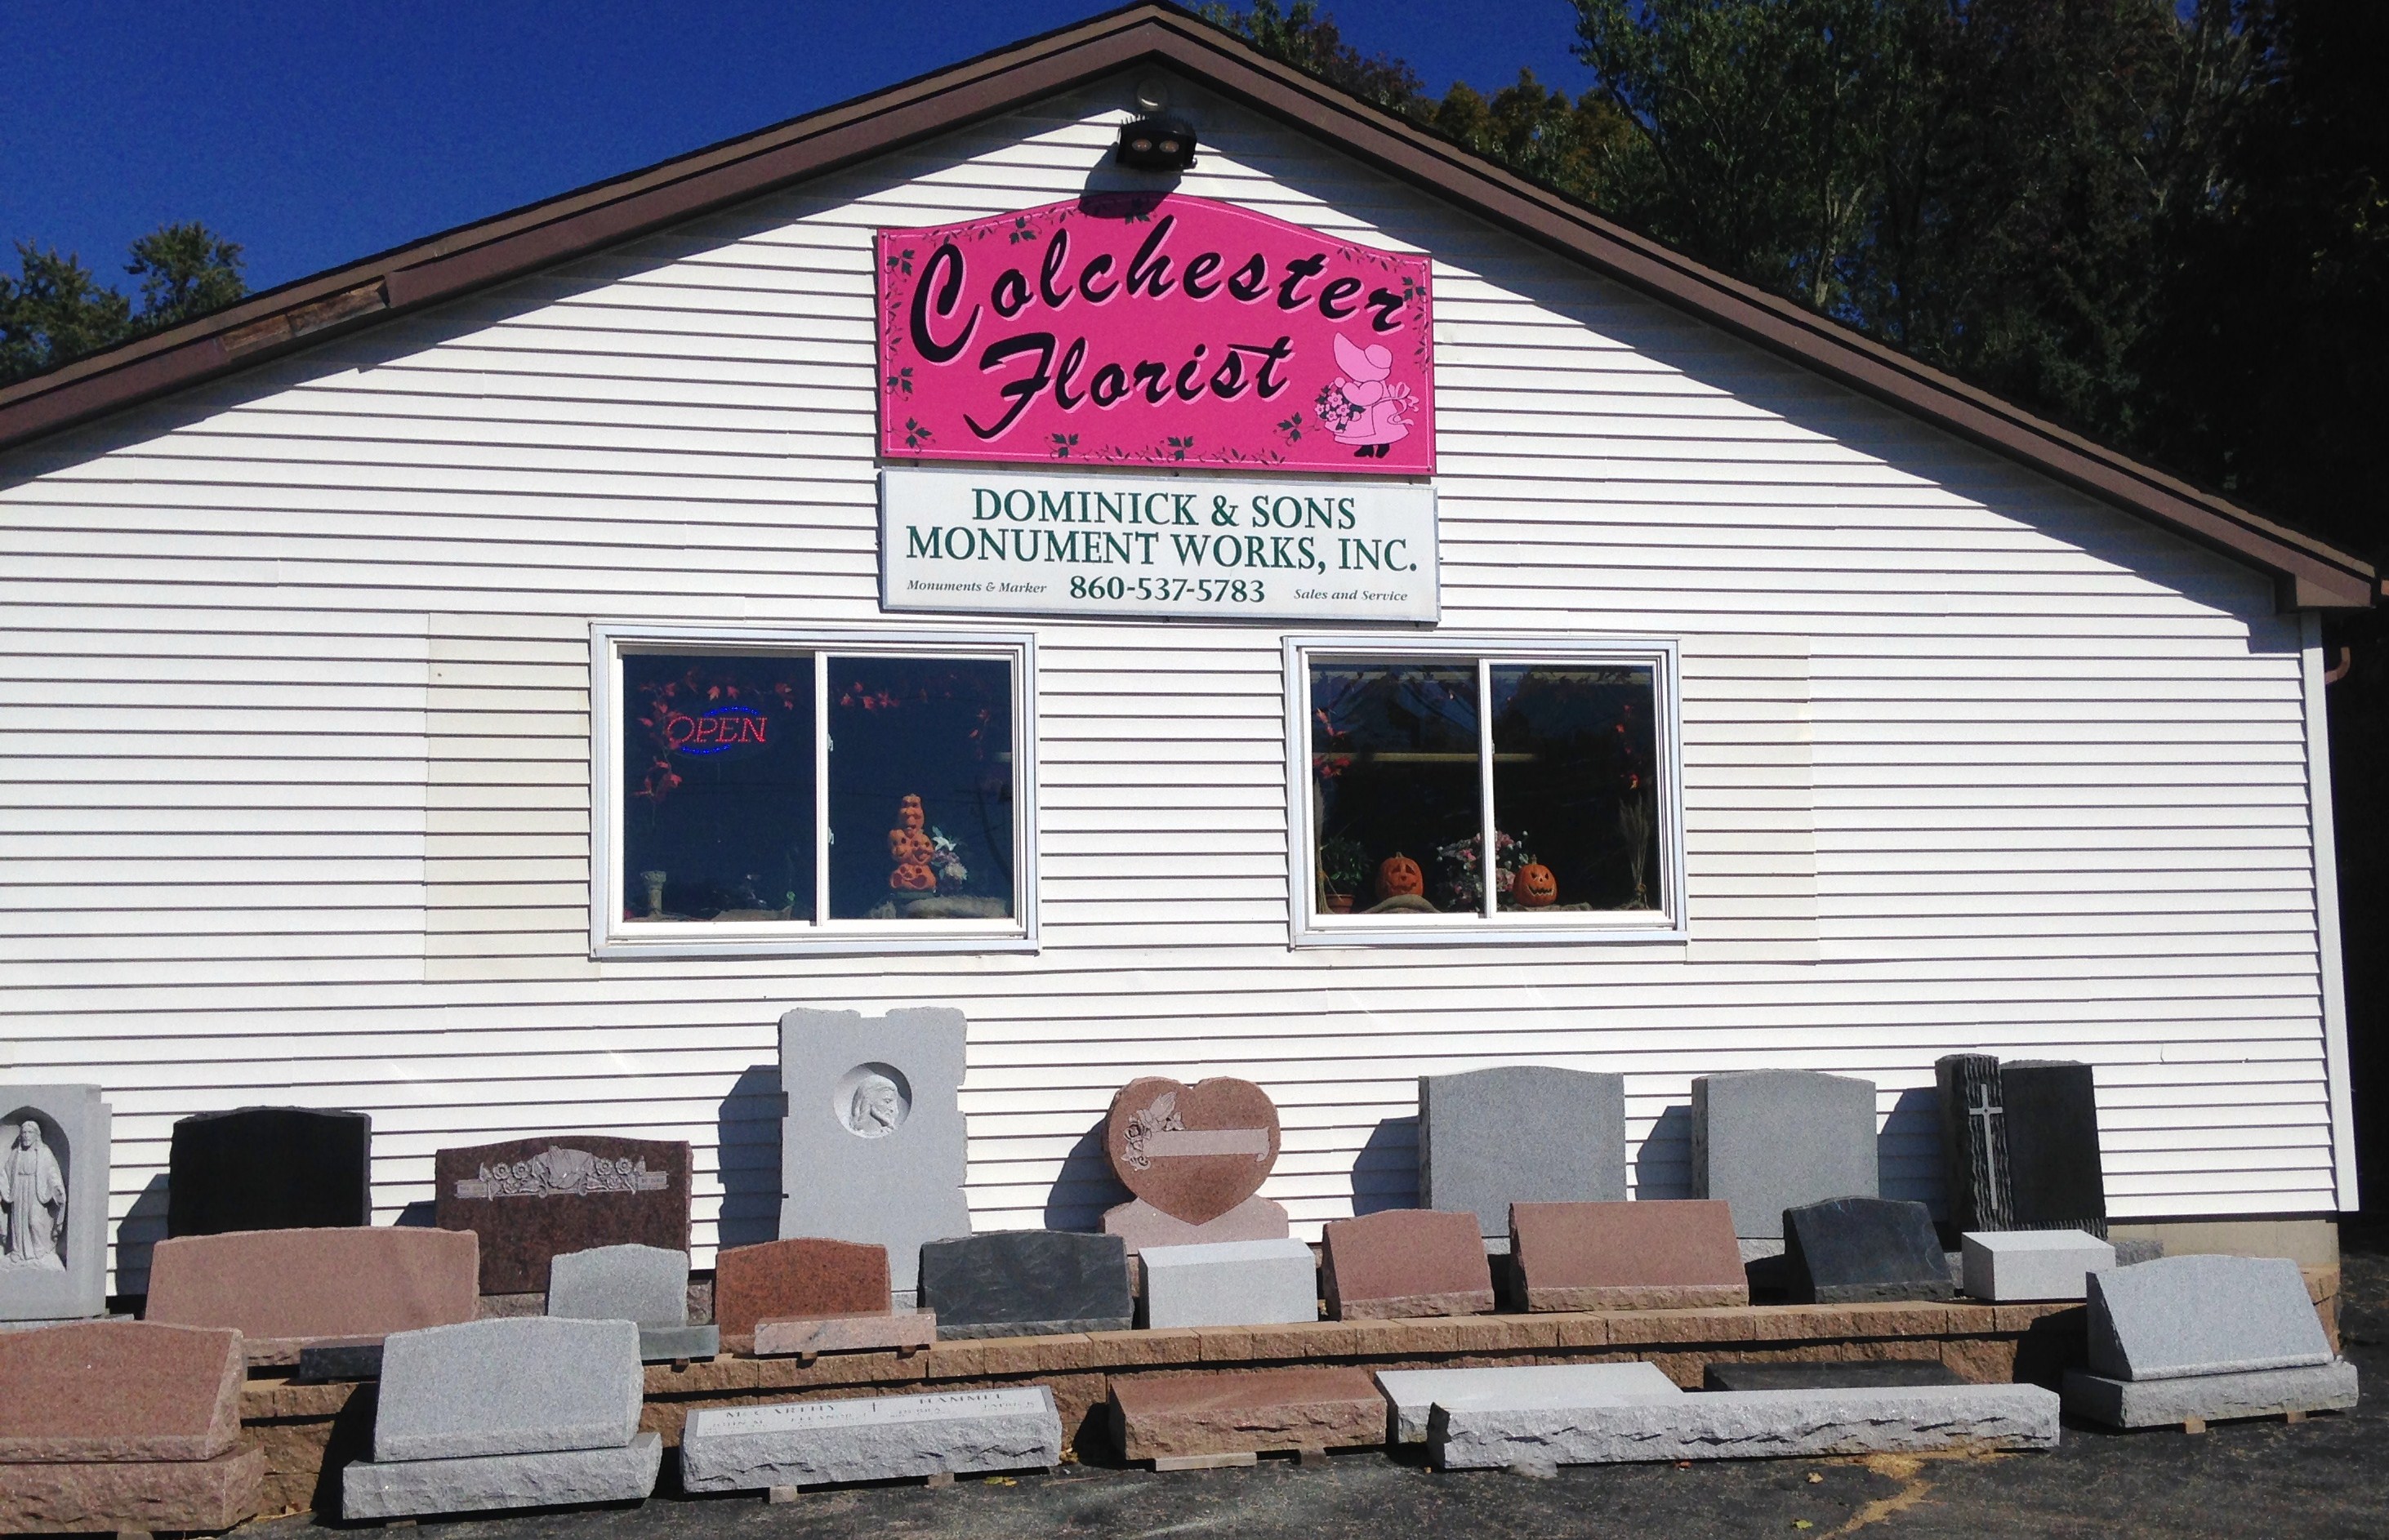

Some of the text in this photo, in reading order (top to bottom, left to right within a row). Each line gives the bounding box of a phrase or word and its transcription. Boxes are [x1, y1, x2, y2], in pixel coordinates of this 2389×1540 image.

[909, 214, 1404, 363] Colchester
[963, 331, 1295, 440] Florist
[972, 488, 1355, 529] DOMINICK & SONS
[907, 526, 1416, 575] MONUMENT WORKS, INC.
[907, 580, 1047, 594] Monuments & Marker
[1071, 576, 1264, 603] 860-537-5783
[1293, 589, 1408, 601] Sales and Service
[666, 716, 768, 743] OPEN
